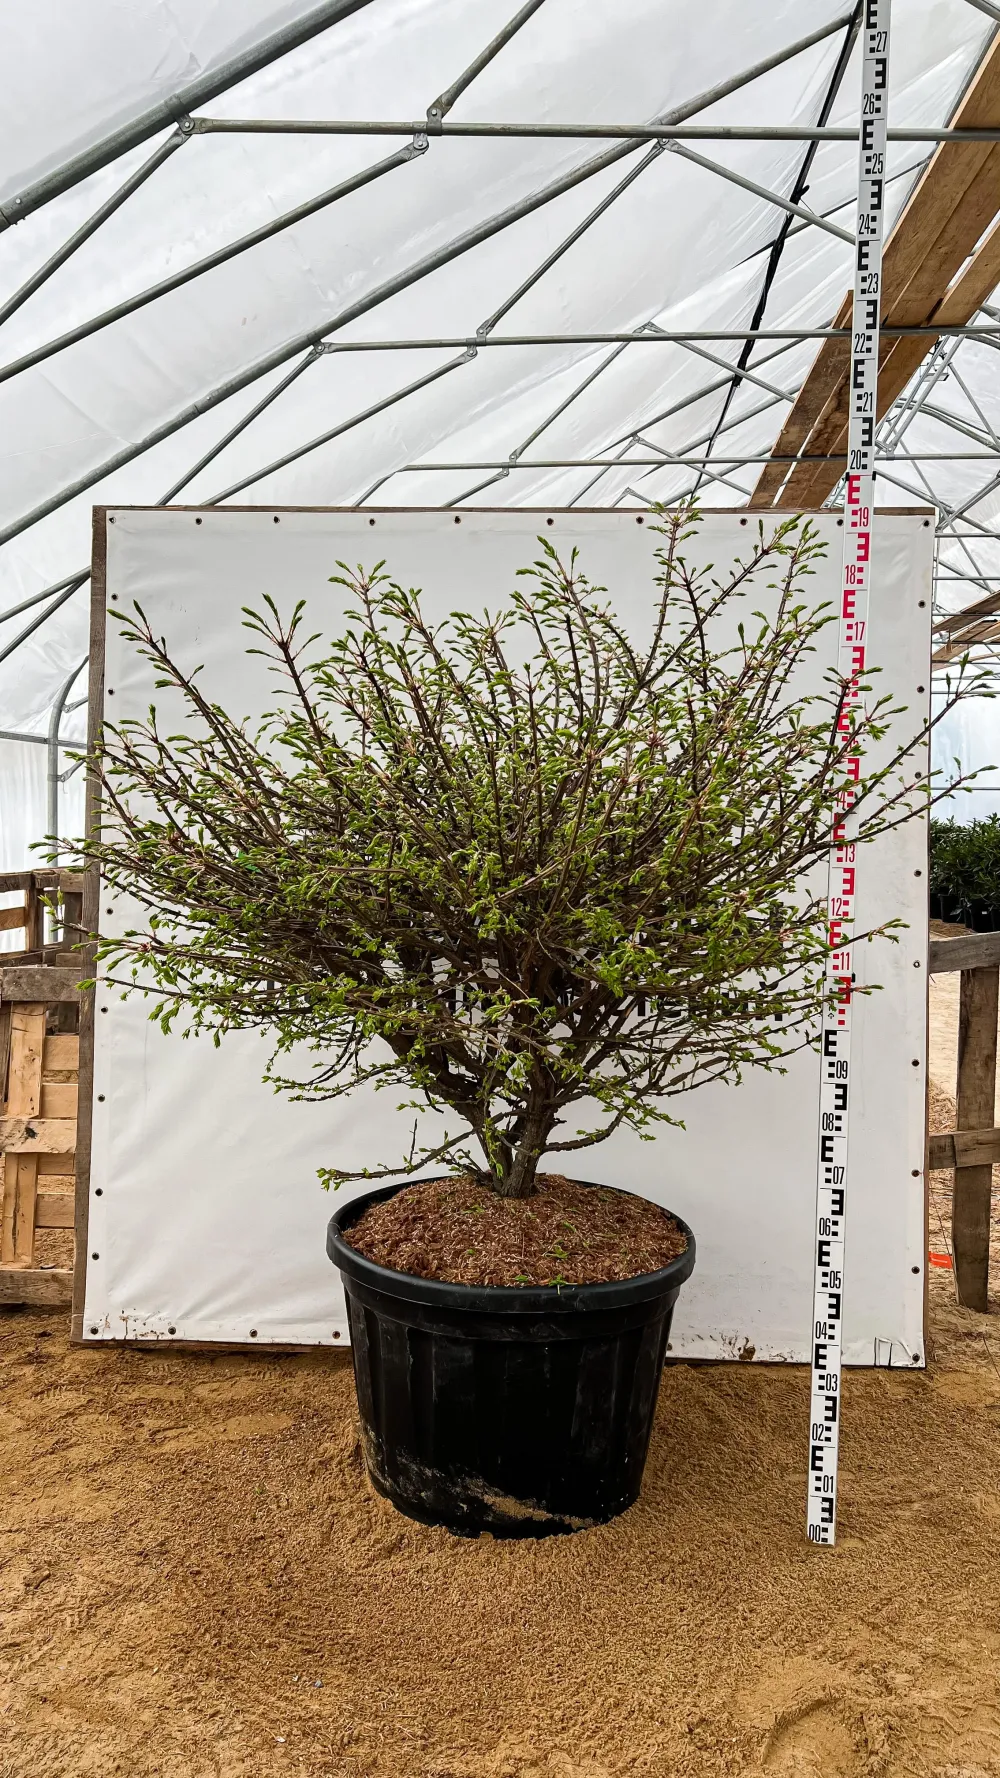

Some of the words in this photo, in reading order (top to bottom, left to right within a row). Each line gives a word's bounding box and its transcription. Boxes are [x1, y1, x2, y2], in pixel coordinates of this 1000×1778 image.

[876, 32, 887, 52] 27
[863, 94, 875, 114] 26
[872, 153, 884, 174] 25
[859, 214, 871, 234] 24
[867, 273, 879, 294] 23
[854, 333, 866, 354] 22
[863, 392, 873, 412] 21
[850, 450, 862, 470] 20
[858, 507, 869, 527] 19
[845, 565, 856, 585] 18
[854, 621, 865, 641] 17
[843, 844, 855, 862] 13
[831, 898, 842, 916] 12
[840, 952, 850, 970] 11
[836, 1060, 847, 1078] 09
[822, 1113, 834, 1131] 08
[833, 1167, 844, 1184] 07
[819, 1218, 830, 1236] 06
[829, 1271, 841, 1289] 05
[815, 1321, 827, 1339] 04
[826, 1373, 838, 1392] 03
[812, 1423, 824, 1441] 02
[823, 1475, 833, 1493] 01
[809, 1524, 820, 1542] 00
